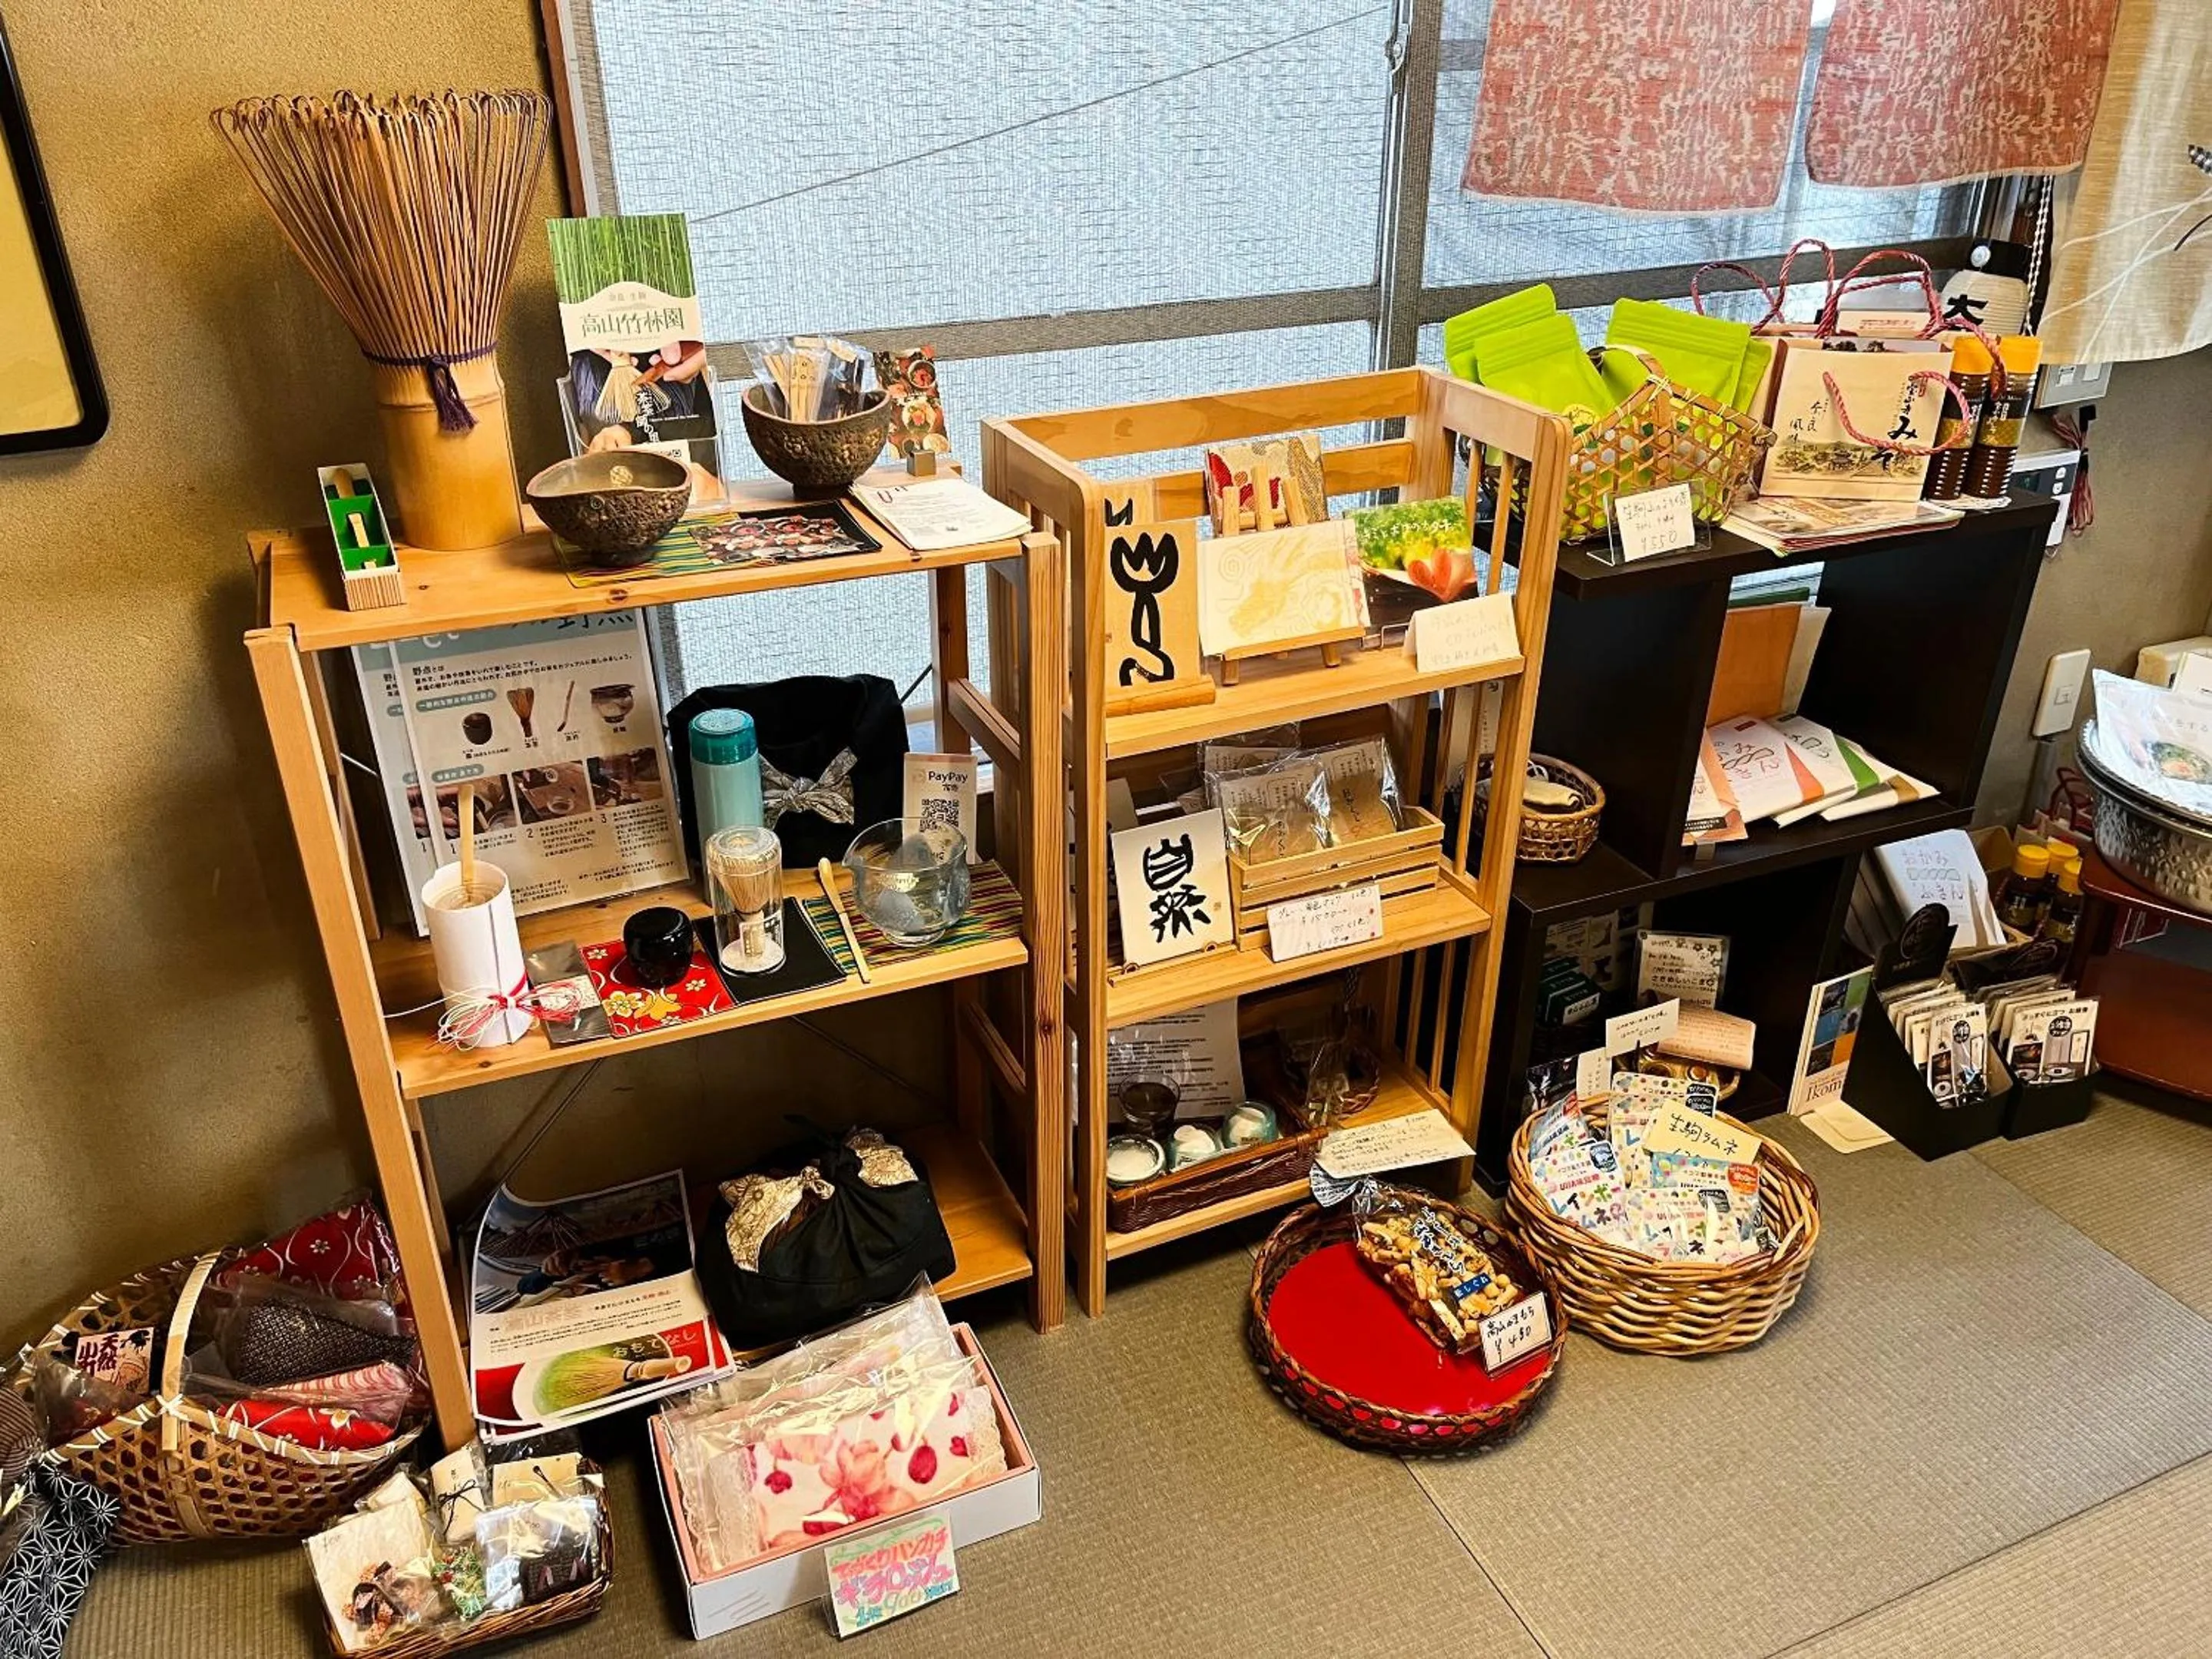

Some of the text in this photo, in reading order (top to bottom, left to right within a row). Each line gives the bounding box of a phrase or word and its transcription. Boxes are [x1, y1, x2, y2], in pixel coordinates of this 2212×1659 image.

[580, 308, 685, 337] 高山竹林園
[928, 770, 968, 783] PayPay
[1668, 1113, 1739, 1156] 生駒ラムネ
[613, 1329, 697, 1358] おもてなし
